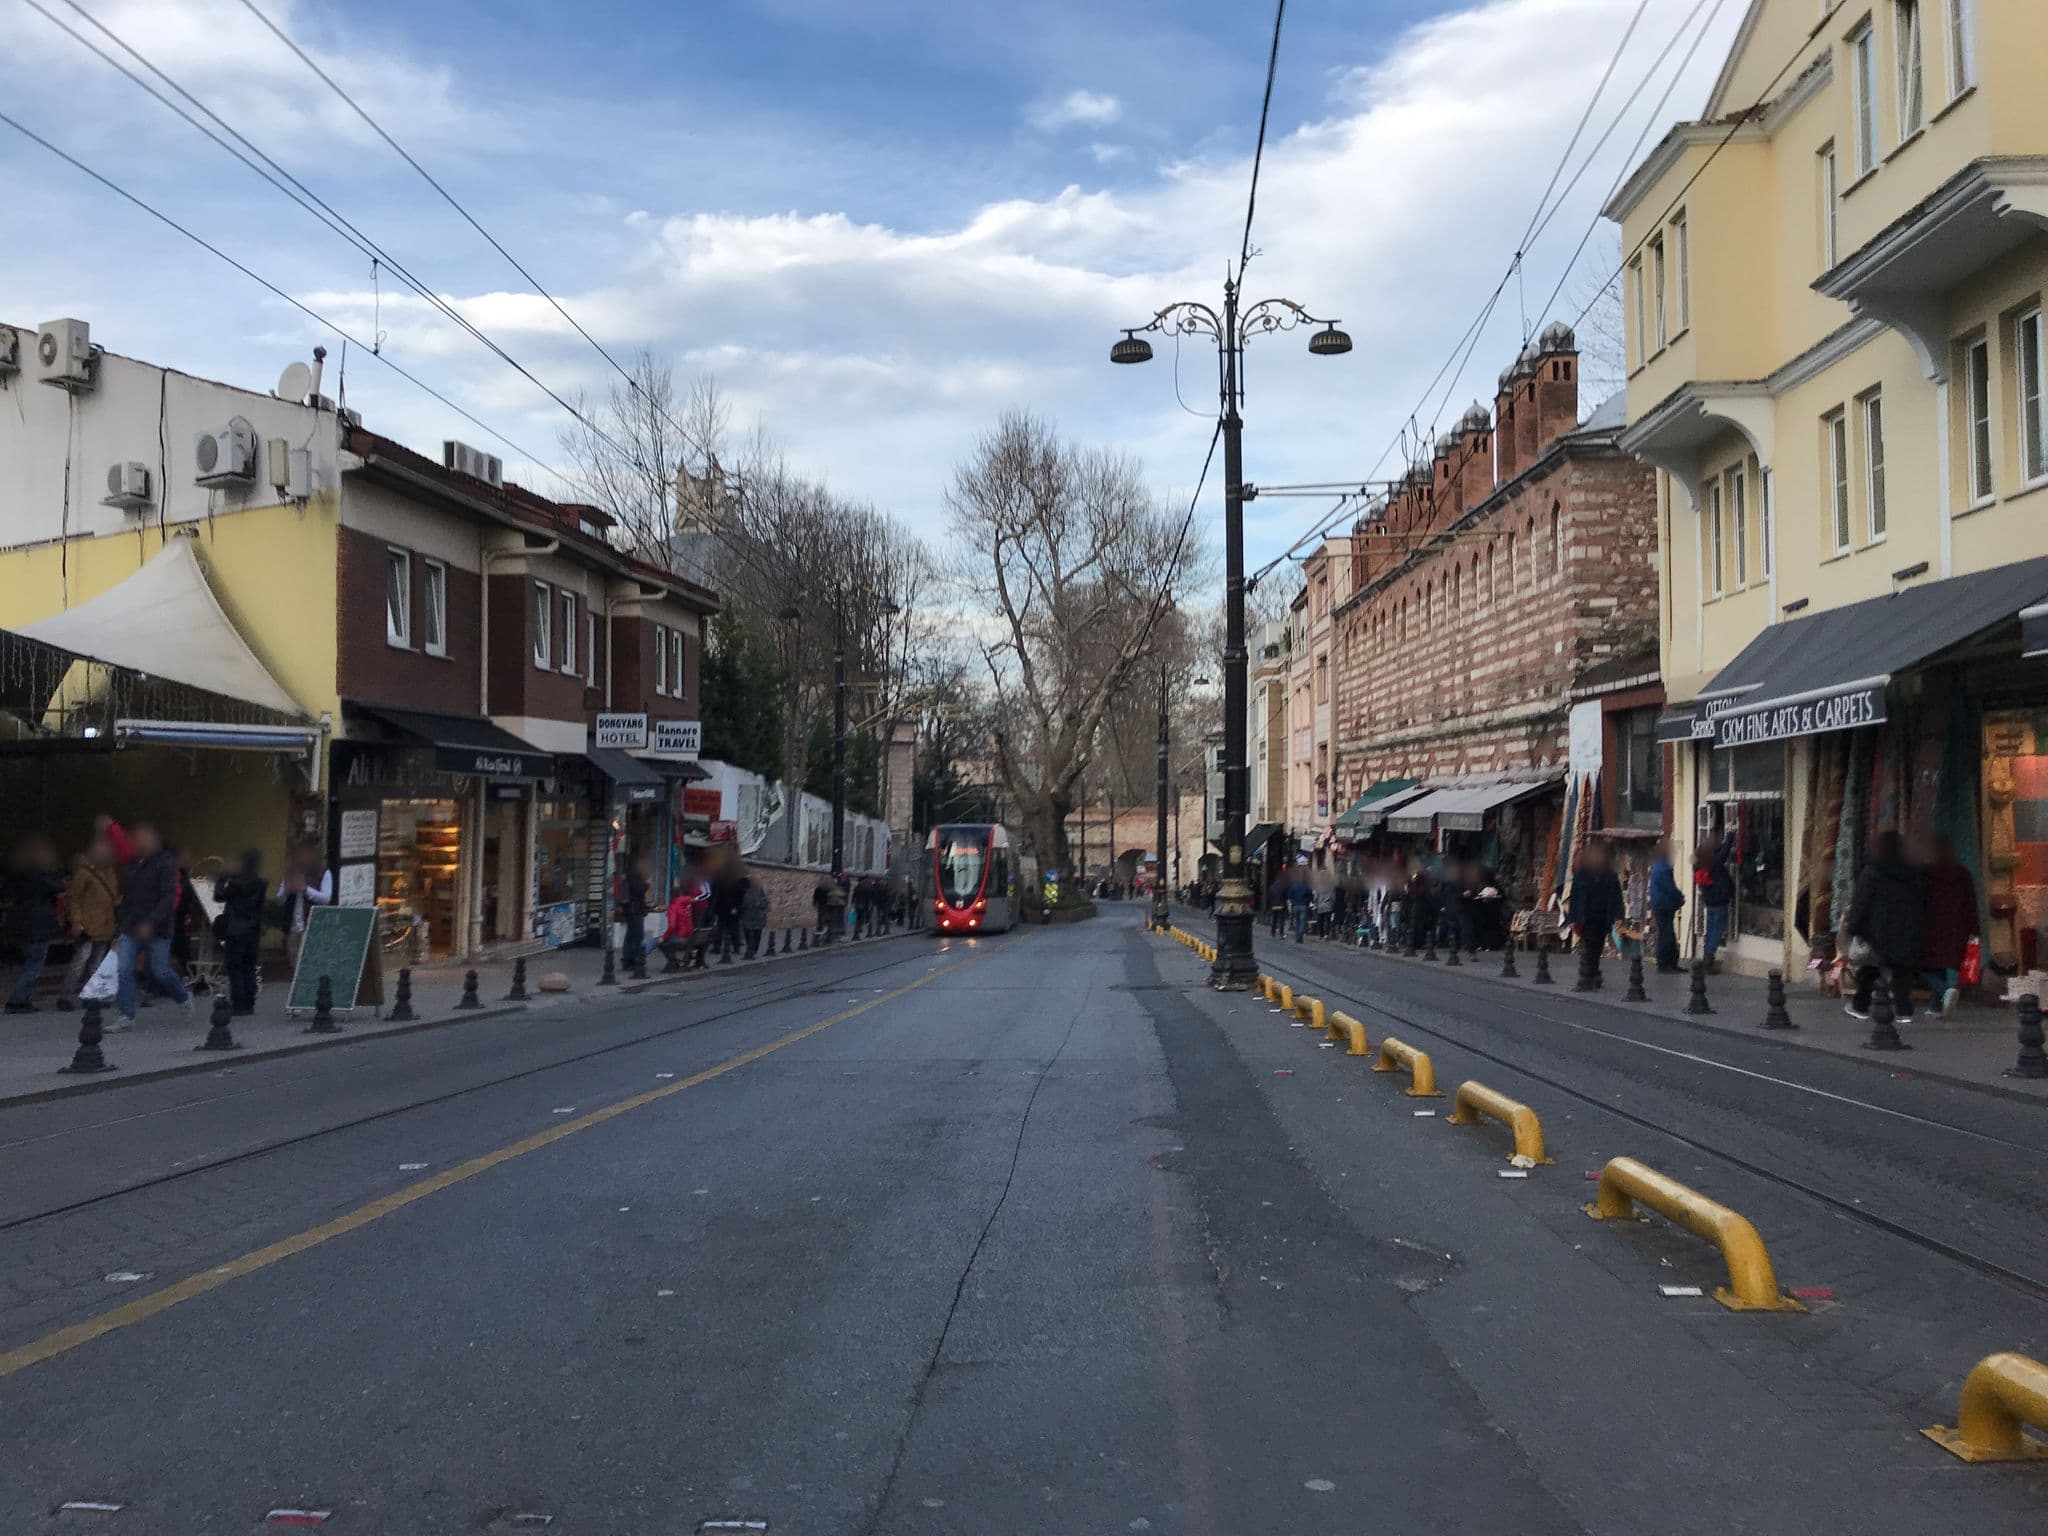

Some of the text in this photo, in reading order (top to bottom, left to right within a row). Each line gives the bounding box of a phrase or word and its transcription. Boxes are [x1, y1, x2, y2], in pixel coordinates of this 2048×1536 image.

[1722, 716, 1744, 744] CKM
[1746, 712, 1769, 740] FINE
[1771, 705, 1798, 736] ARTS
[1801, 706, 1812, 730] &
[1815, 690, 1873, 729] CARPETS
[599, 718, 644, 729] DONGYANG
[601, 732, 638, 744] HOTEL
[659, 738, 697, 748] TRAVEL
